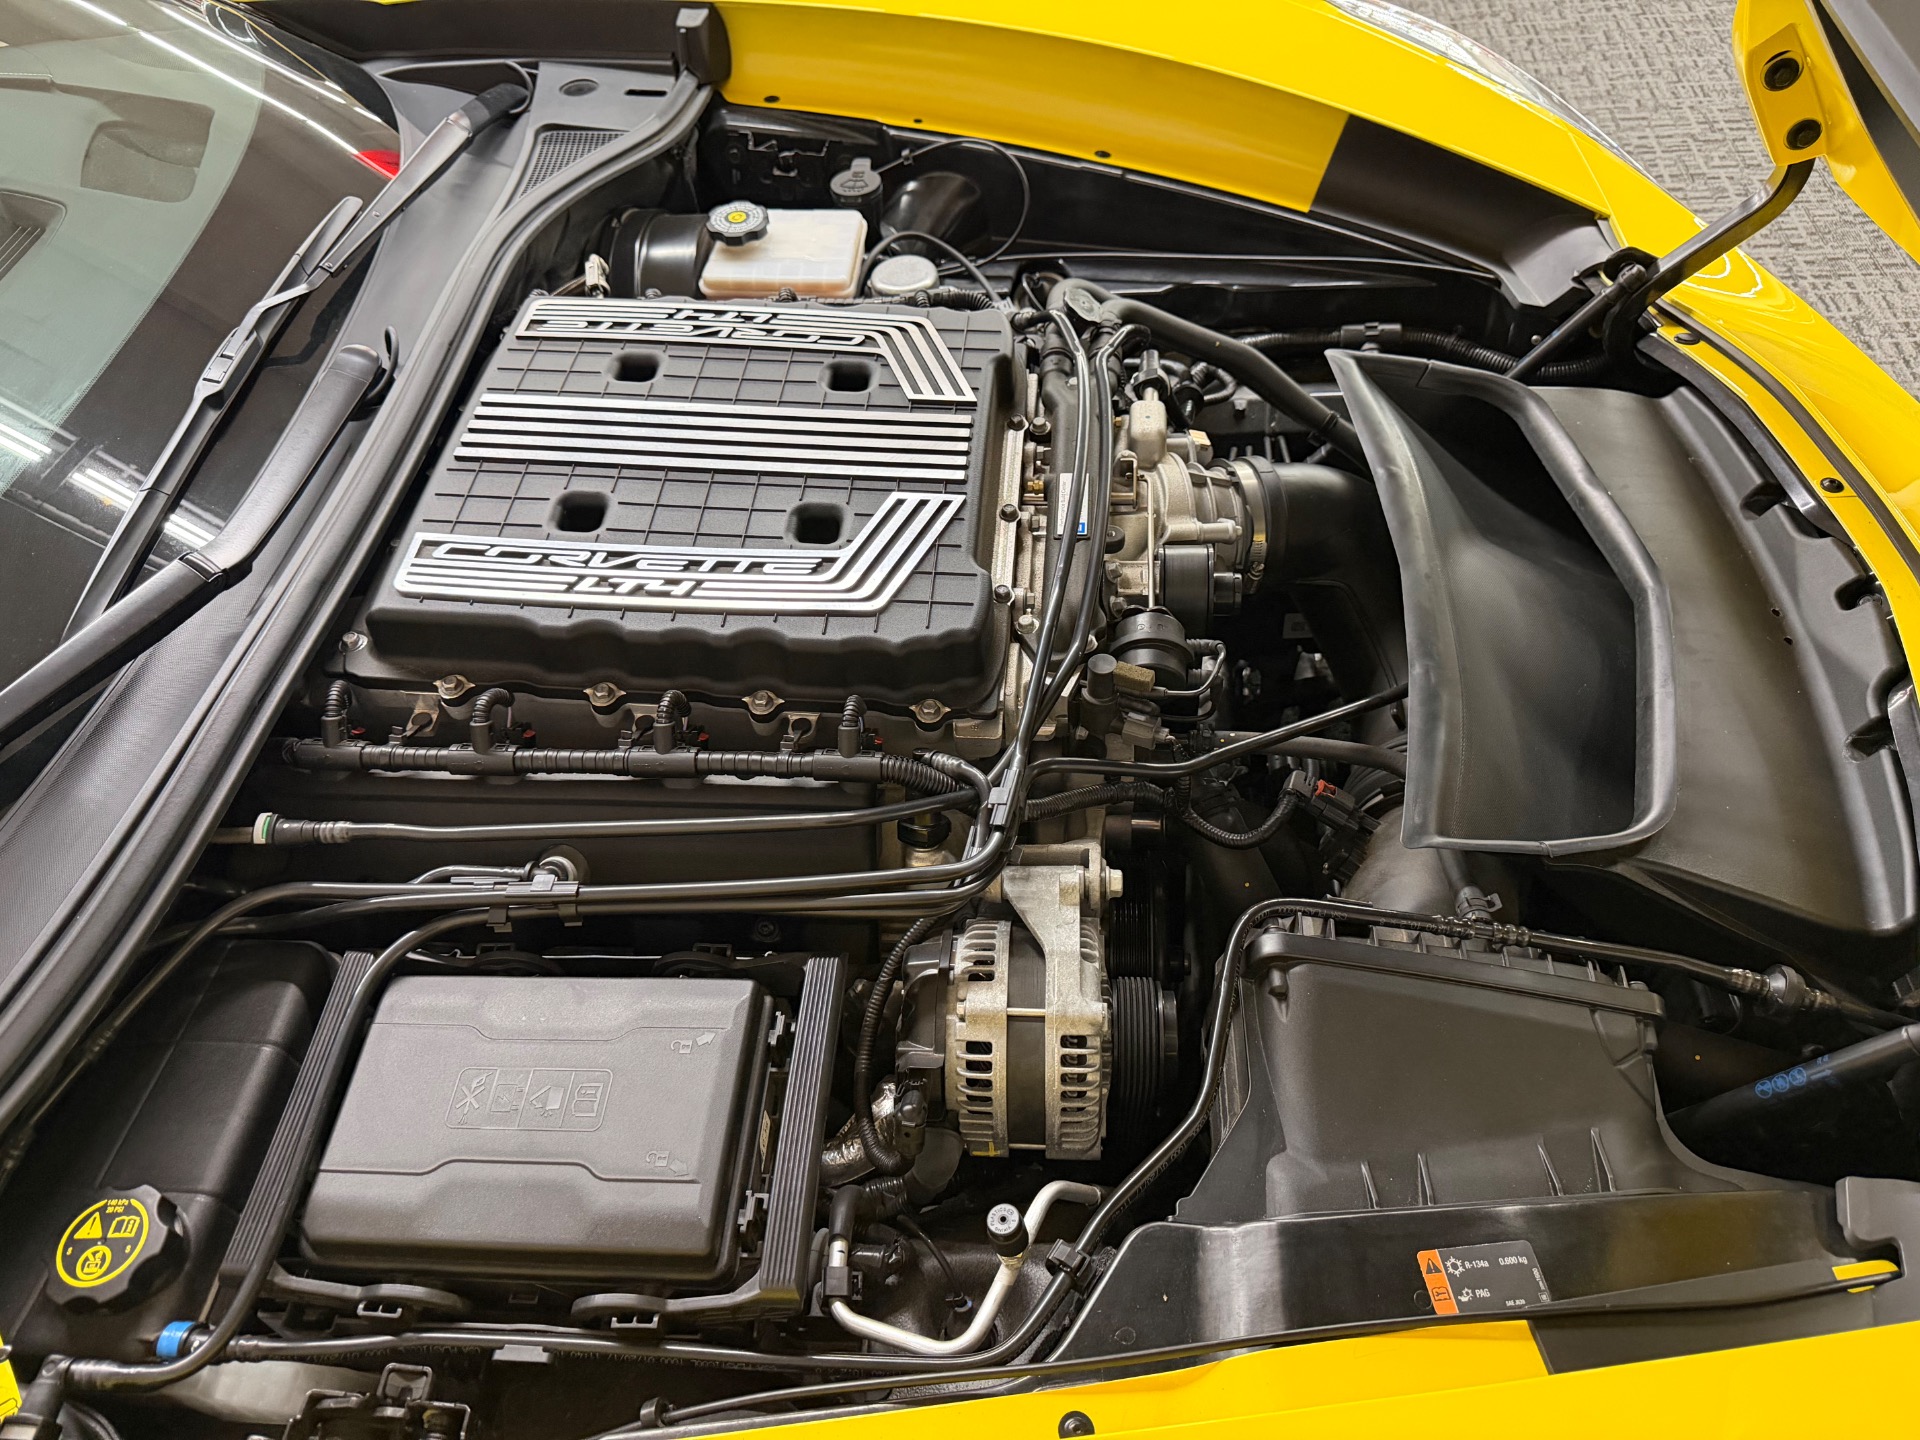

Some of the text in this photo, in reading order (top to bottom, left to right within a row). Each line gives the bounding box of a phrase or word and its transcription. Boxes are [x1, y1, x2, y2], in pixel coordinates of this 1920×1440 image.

[673, 309, 775, 324] LT4
[536, 320, 867, 346] CORVETTE
[432, 542, 823, 575] CORVETTE
[569, 576, 699, 597] LT4
[1464, 1255, 1528, 1270] R-134a 0.600 kg
[1475, 1288, 1491, 1298] PAG
